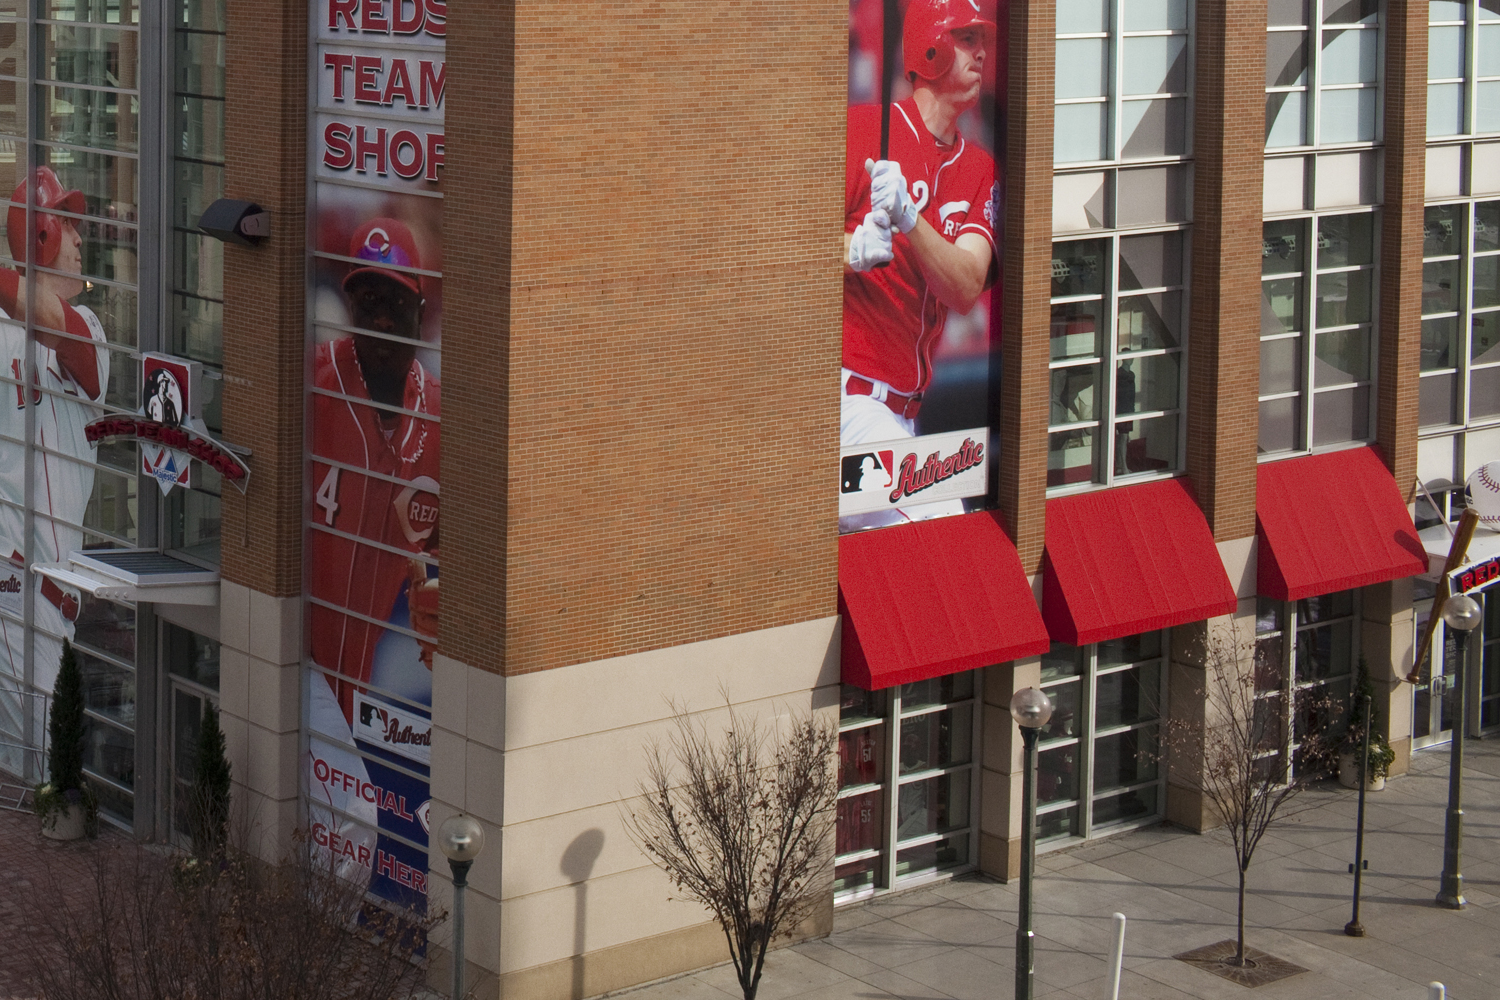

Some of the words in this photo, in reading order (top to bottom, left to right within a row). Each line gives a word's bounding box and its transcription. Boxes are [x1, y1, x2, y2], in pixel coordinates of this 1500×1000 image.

[324, 52, 446, 108] TEAM
[152, 468, 177, 484] Majestic
[316, 465, 339, 526] 4
[889, 437, 984, 504] Authentic
[313, 758, 414, 822] OFFICIAL
[311, 822, 371, 868] GEAR
